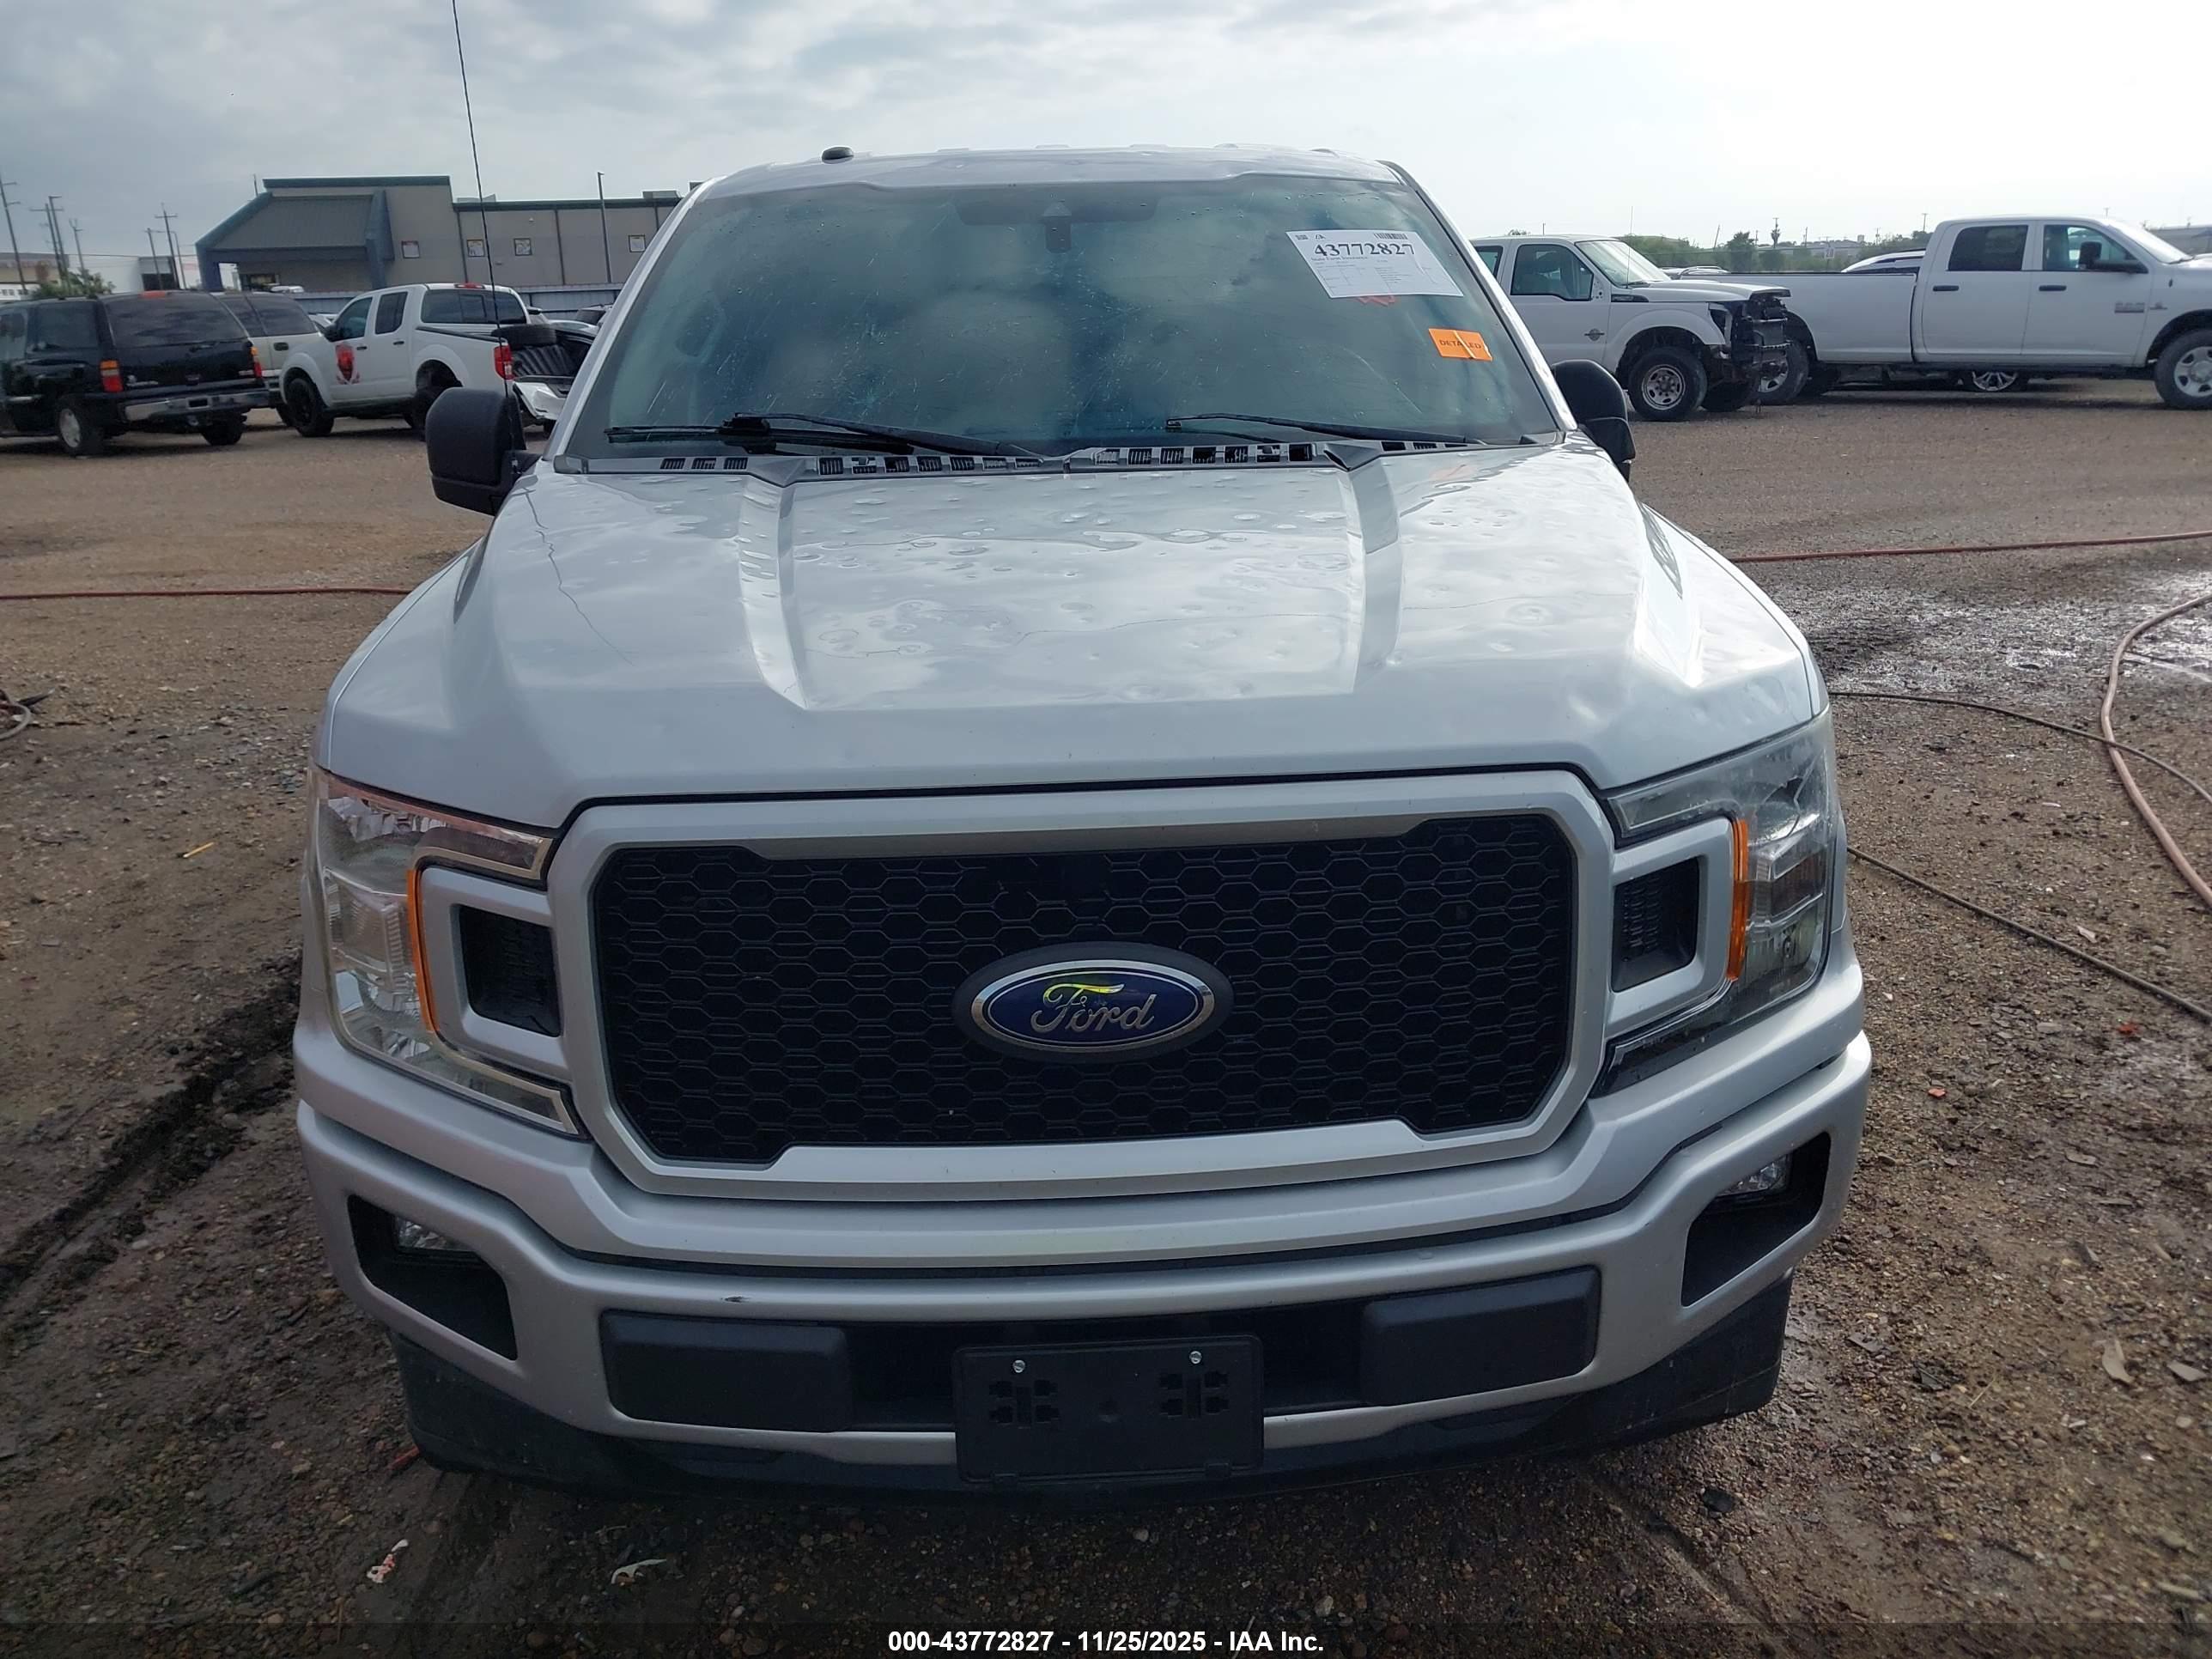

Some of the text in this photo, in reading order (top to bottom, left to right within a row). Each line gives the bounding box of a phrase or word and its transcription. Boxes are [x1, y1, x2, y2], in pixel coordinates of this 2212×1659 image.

[1314, 243, 1415, 257] 43772827
[1439, 339, 1481, 349] DETALED
[1030, 983, 1158, 1034] Ford
